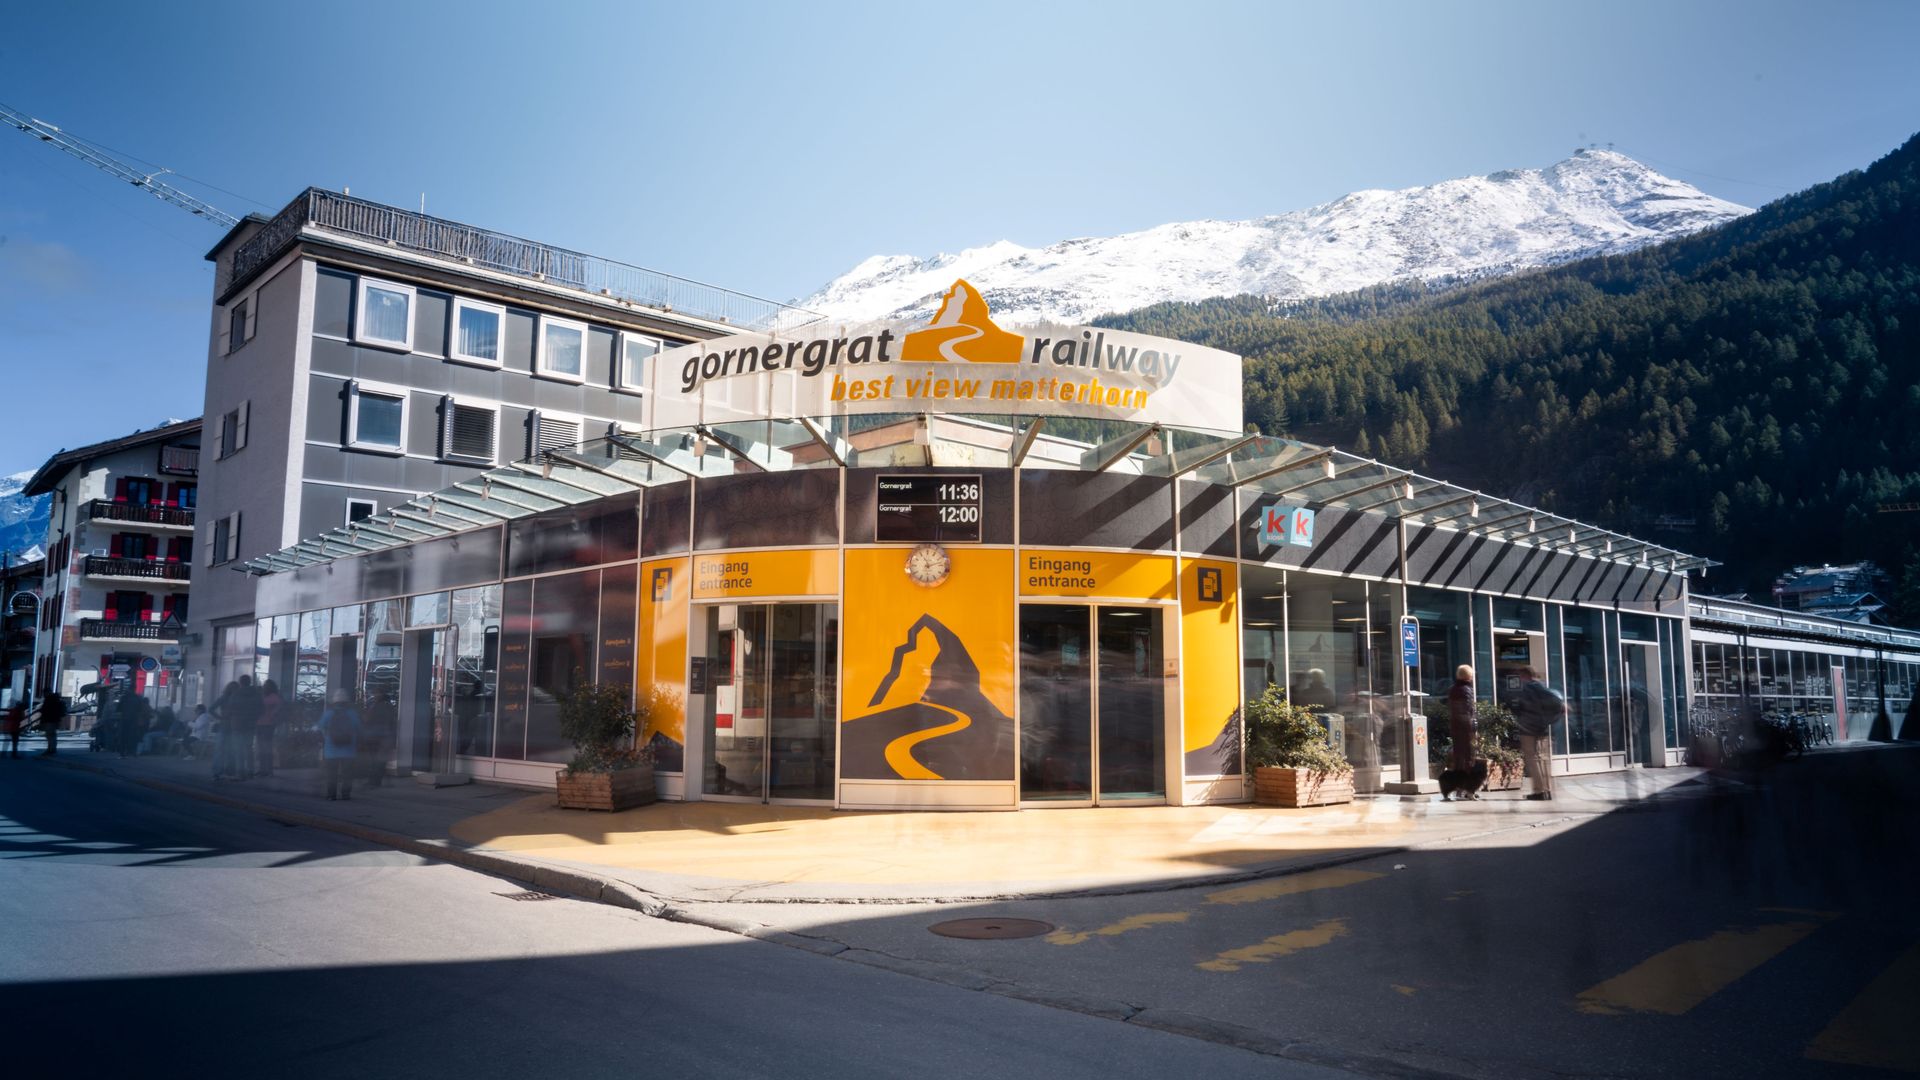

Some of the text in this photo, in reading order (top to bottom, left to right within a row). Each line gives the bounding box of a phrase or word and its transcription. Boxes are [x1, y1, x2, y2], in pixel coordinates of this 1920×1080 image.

[681, 329, 1181, 392] gornergrat railway
[831, 373, 1148, 408] best view matterhorn
[939, 484, 978, 500] 11:36
[939, 507, 978, 523] 12:00
[701, 561, 749, 576] Eingang
[1029, 557, 1091, 575] Eingang
[701, 578, 752, 590] entrance
[1029, 575, 1096, 588] entrance
